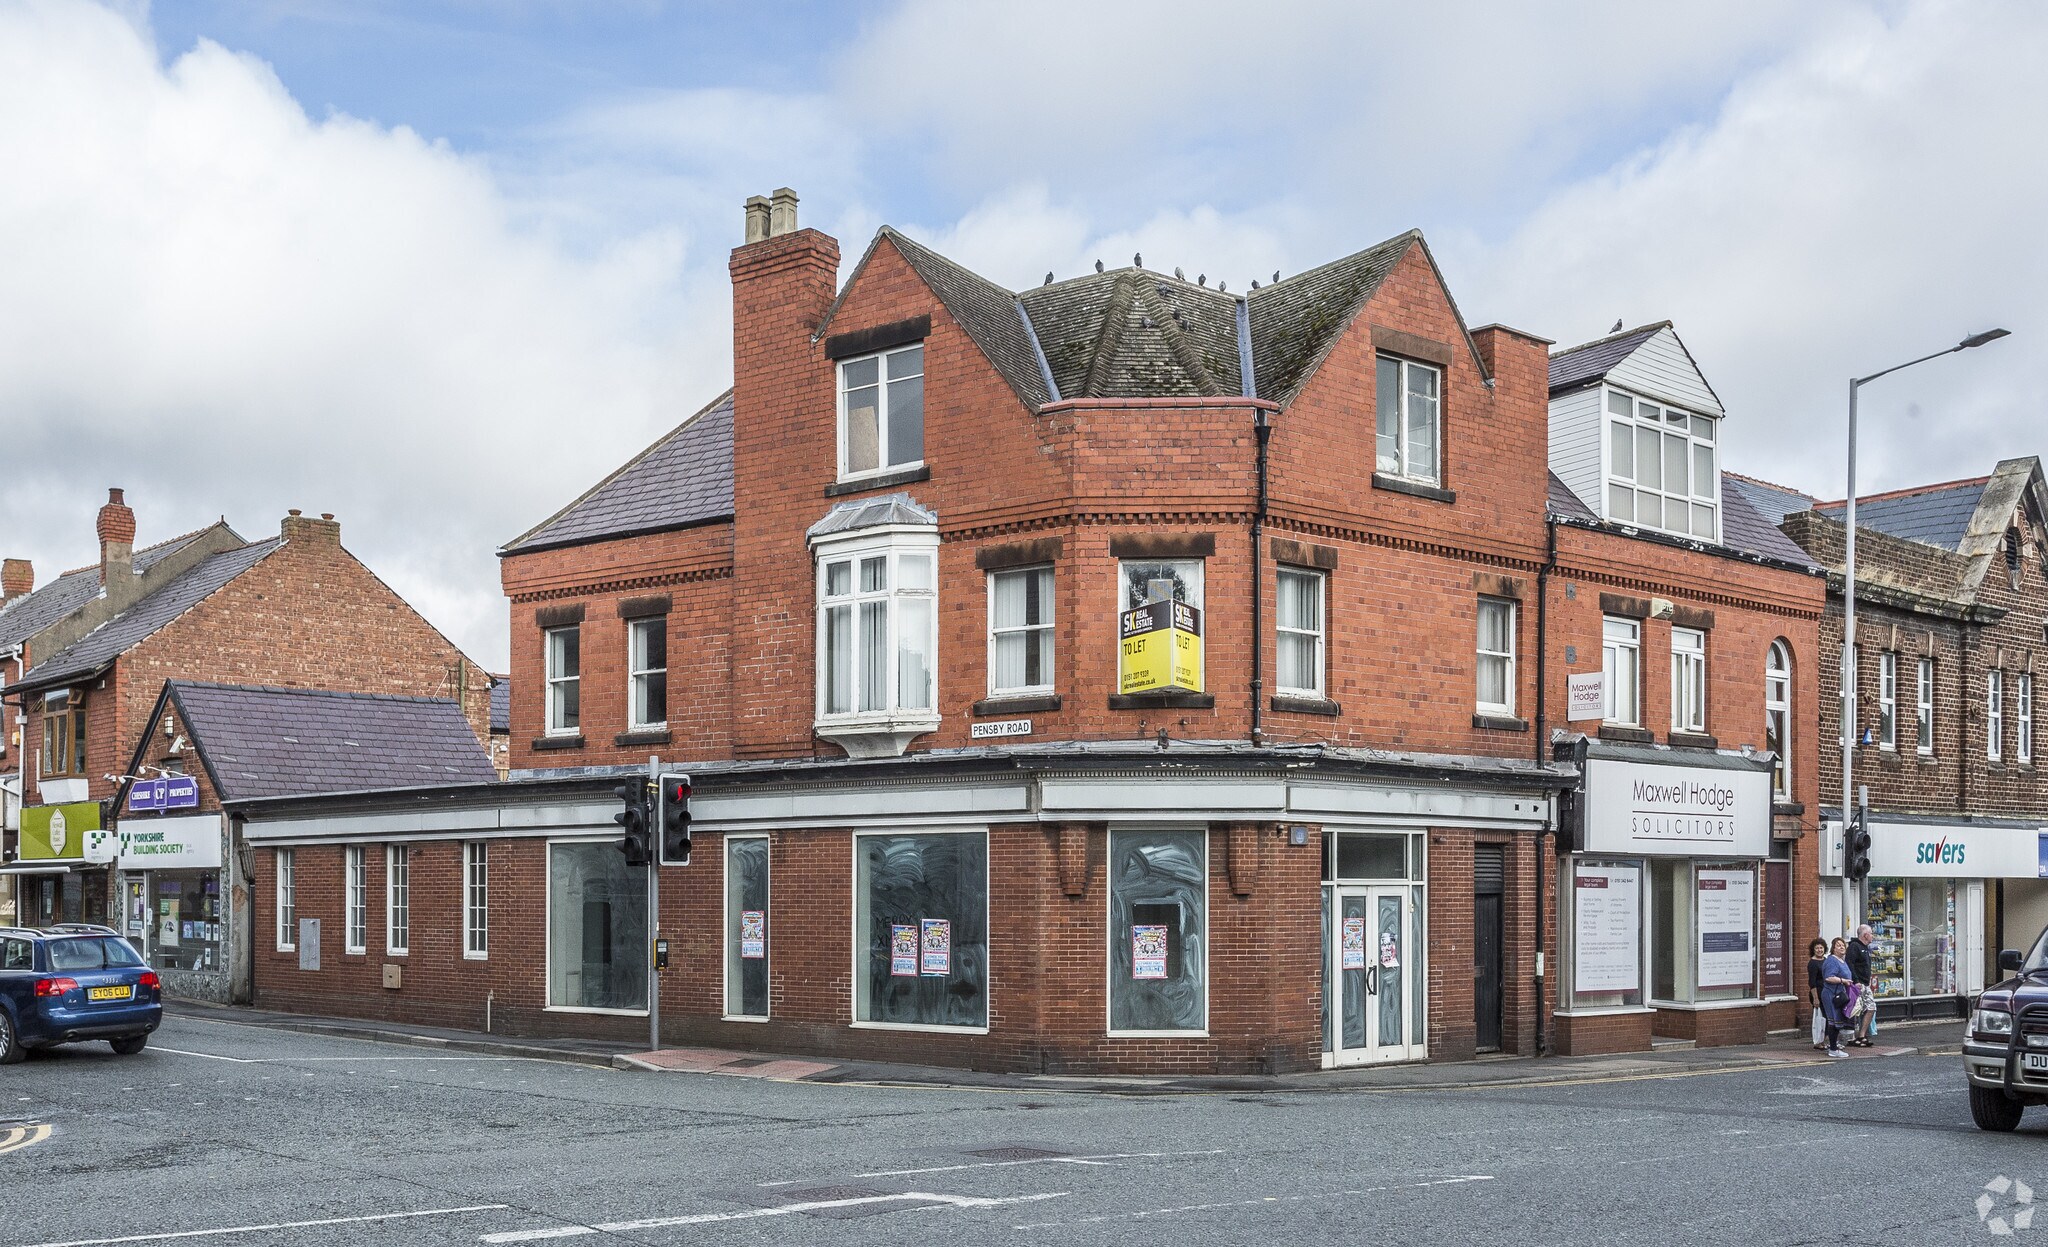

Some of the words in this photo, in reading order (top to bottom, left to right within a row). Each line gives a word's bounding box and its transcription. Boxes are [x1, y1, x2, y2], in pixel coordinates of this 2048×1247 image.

[1136, 609, 1148, 619] REAL
[1136, 616, 1153, 629] ESTATE
[1124, 643, 1131, 656] TO
[1133, 639, 1146, 654] LET
[1182, 636, 1190, 650] LET
[1571, 681, 1602, 692] Maxwell
[1573, 692, 1600, 702] Hodge
[973, 724, 1004, 736] PENSBY
[1007, 722, 1029, 733] ROAD
[169, 786, 193, 797] PROPERTIES
[1633, 780, 1687, 804] Maxwell
[1690, 782, 1734, 811] Hodge
[1632, 817, 1734, 836] SOLICITORS
[133, 832, 164, 843] YORKSHIRE
[133, 844, 159, 855] BUILDING
[159, 843, 184, 854] SOCIETY
[1916, 834, 1965, 864] savers
[1767, 931, 1781, 940] Hodge
[92, 988, 113, 998] EY06
[114, 986, 130, 996] CUJ
